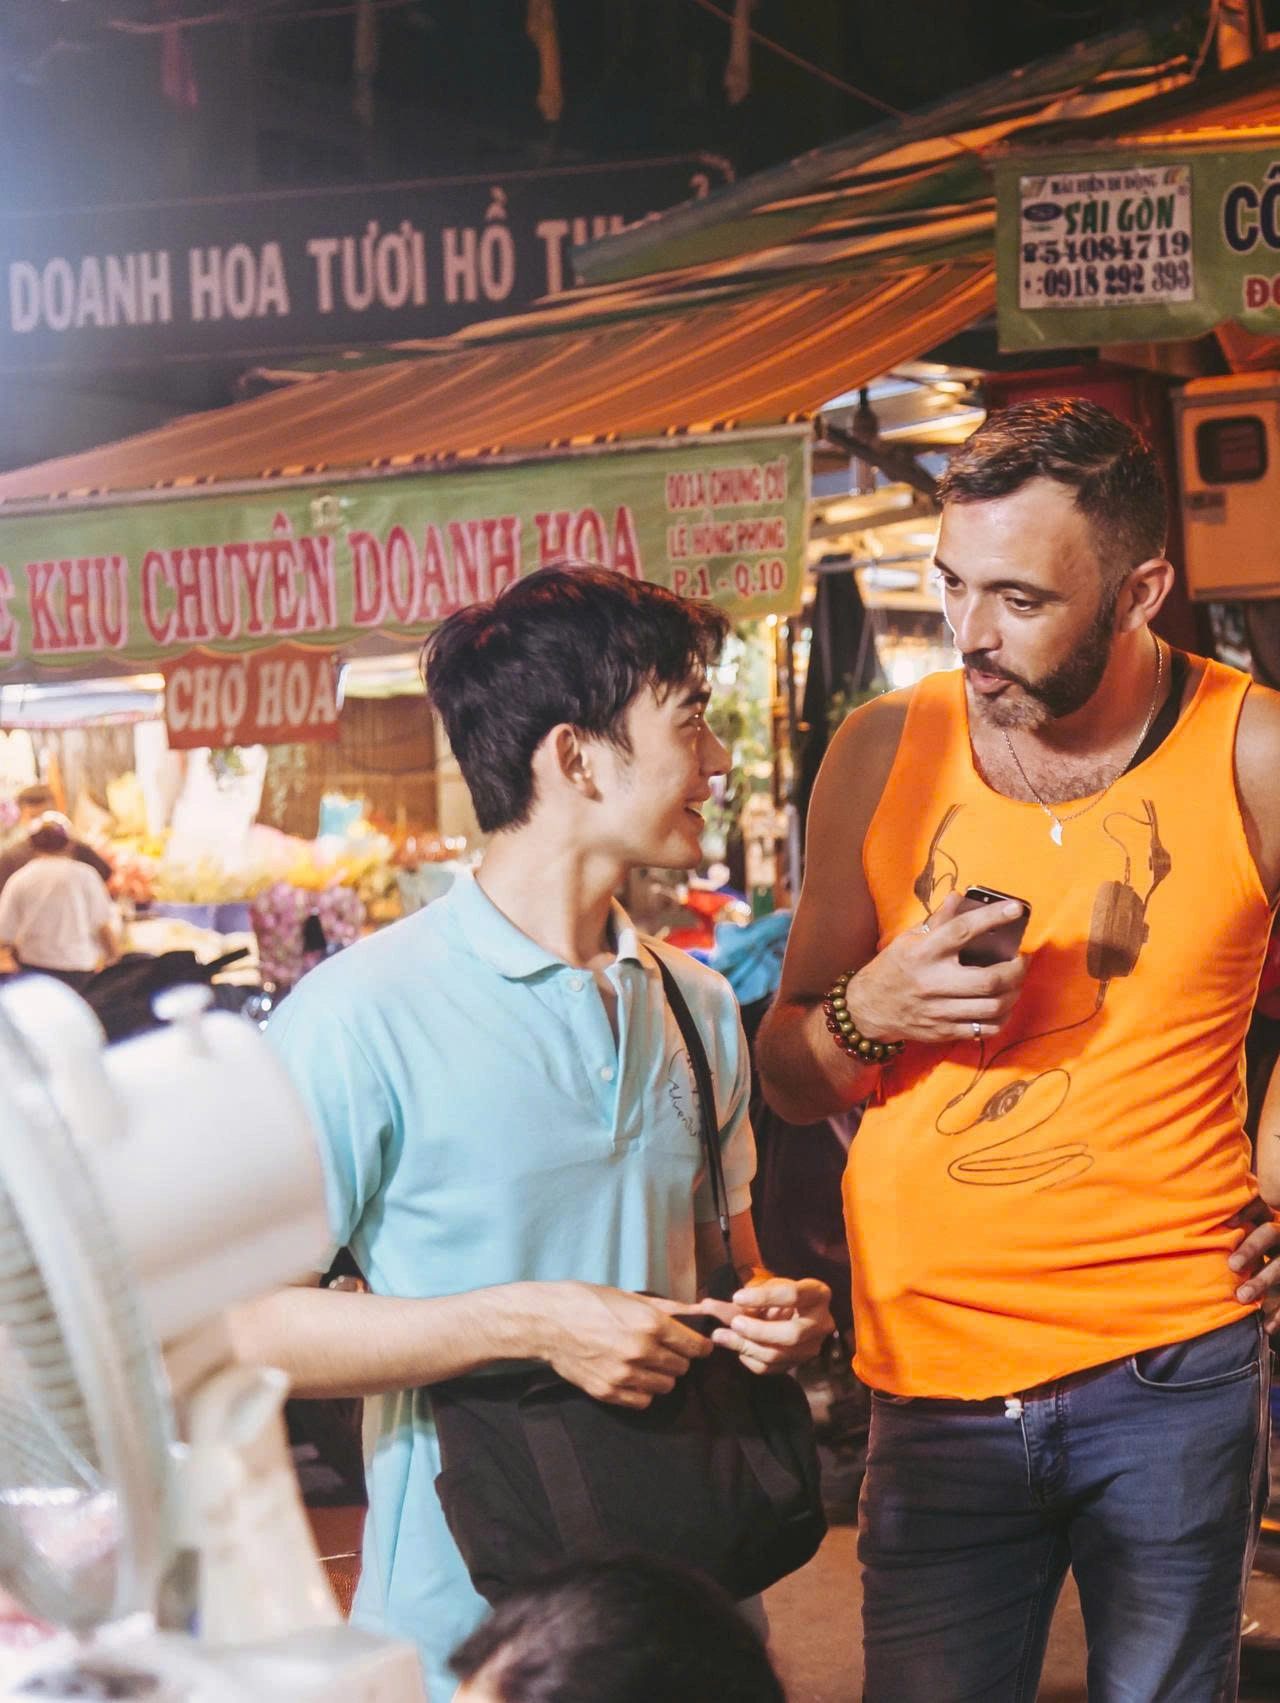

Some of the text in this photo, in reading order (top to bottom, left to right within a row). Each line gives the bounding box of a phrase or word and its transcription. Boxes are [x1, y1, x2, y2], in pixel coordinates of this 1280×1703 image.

[1064, 194, 1110, 236] SÀI
[1116, 190, 1175, 232] GÒN
[9, 248, 174, 334] DOANH
[188, 241, 292, 322] HOA
[305, 218, 428, 314] TƯƠI
[441, 184, 516, 303] HỒ
[25, 554, 128, 652] KHU
[141, 510, 338, 647] CHUYÊN
[347, 514, 522, 628] DOANH
[535, 504, 645, 582] HOA
[672, 564, 711, 600] P.1
[732, 557, 787, 600] Q.10
[256, 658, 338, 728] HOA
